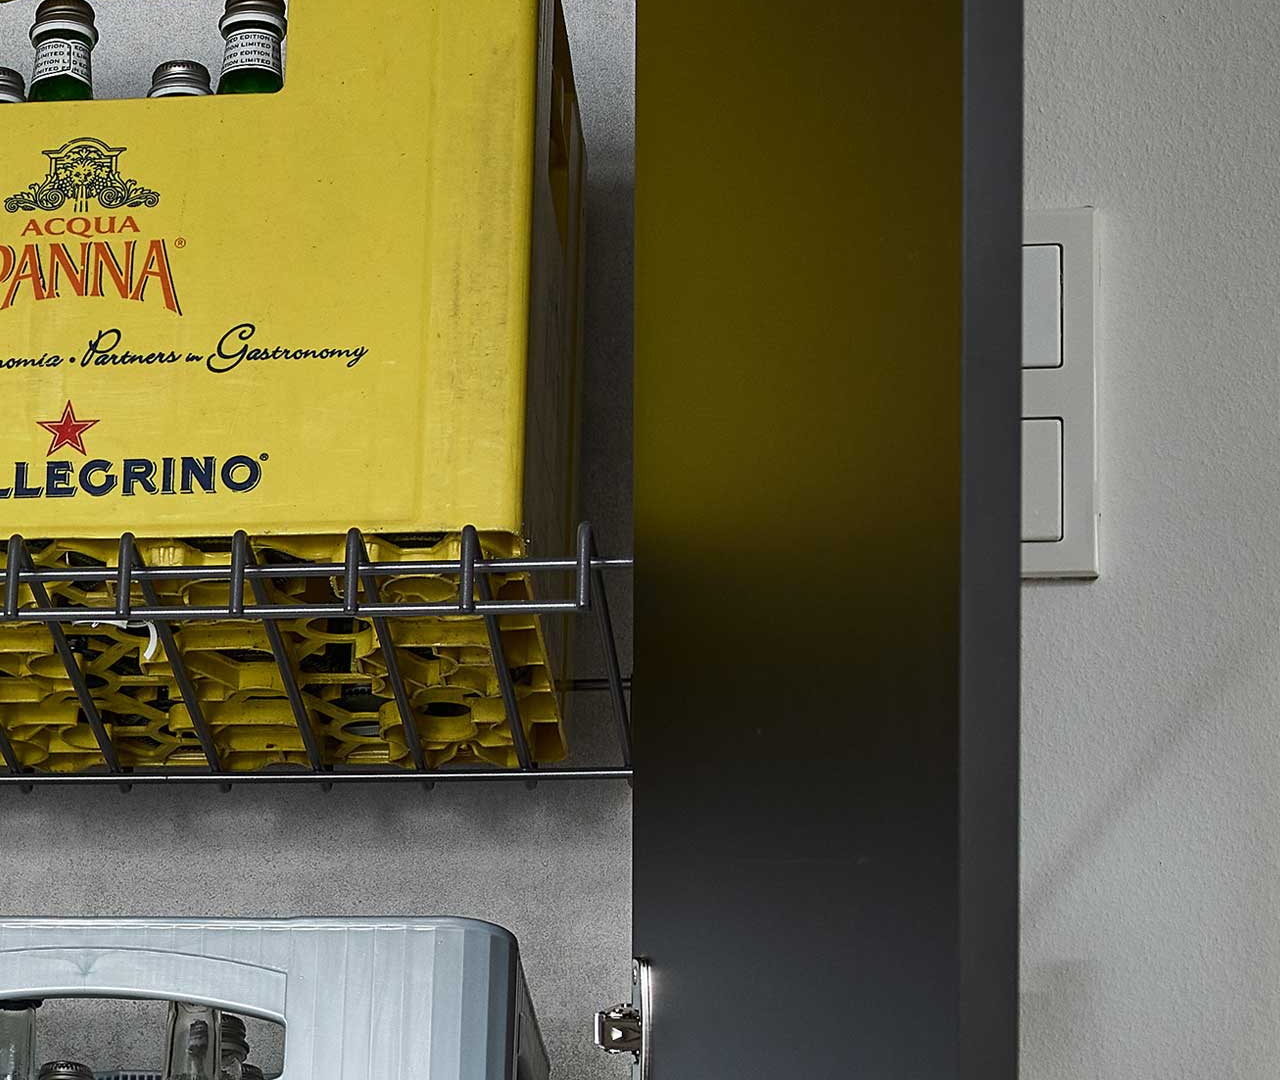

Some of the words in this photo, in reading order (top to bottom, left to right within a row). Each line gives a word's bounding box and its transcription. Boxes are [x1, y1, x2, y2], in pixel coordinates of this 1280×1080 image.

[240, 34, 271, 42] EDITION
[241, 42, 271, 50] LIMITED
[240, 49, 271, 58] EDITION
[241, 58, 271, 66] LIMITED
[21, 216, 140, 238] ACQUA
[80, 328, 183, 367] Partners
[185, 352, 204, 362] in
[206, 323, 370, 373] Gastronomy
